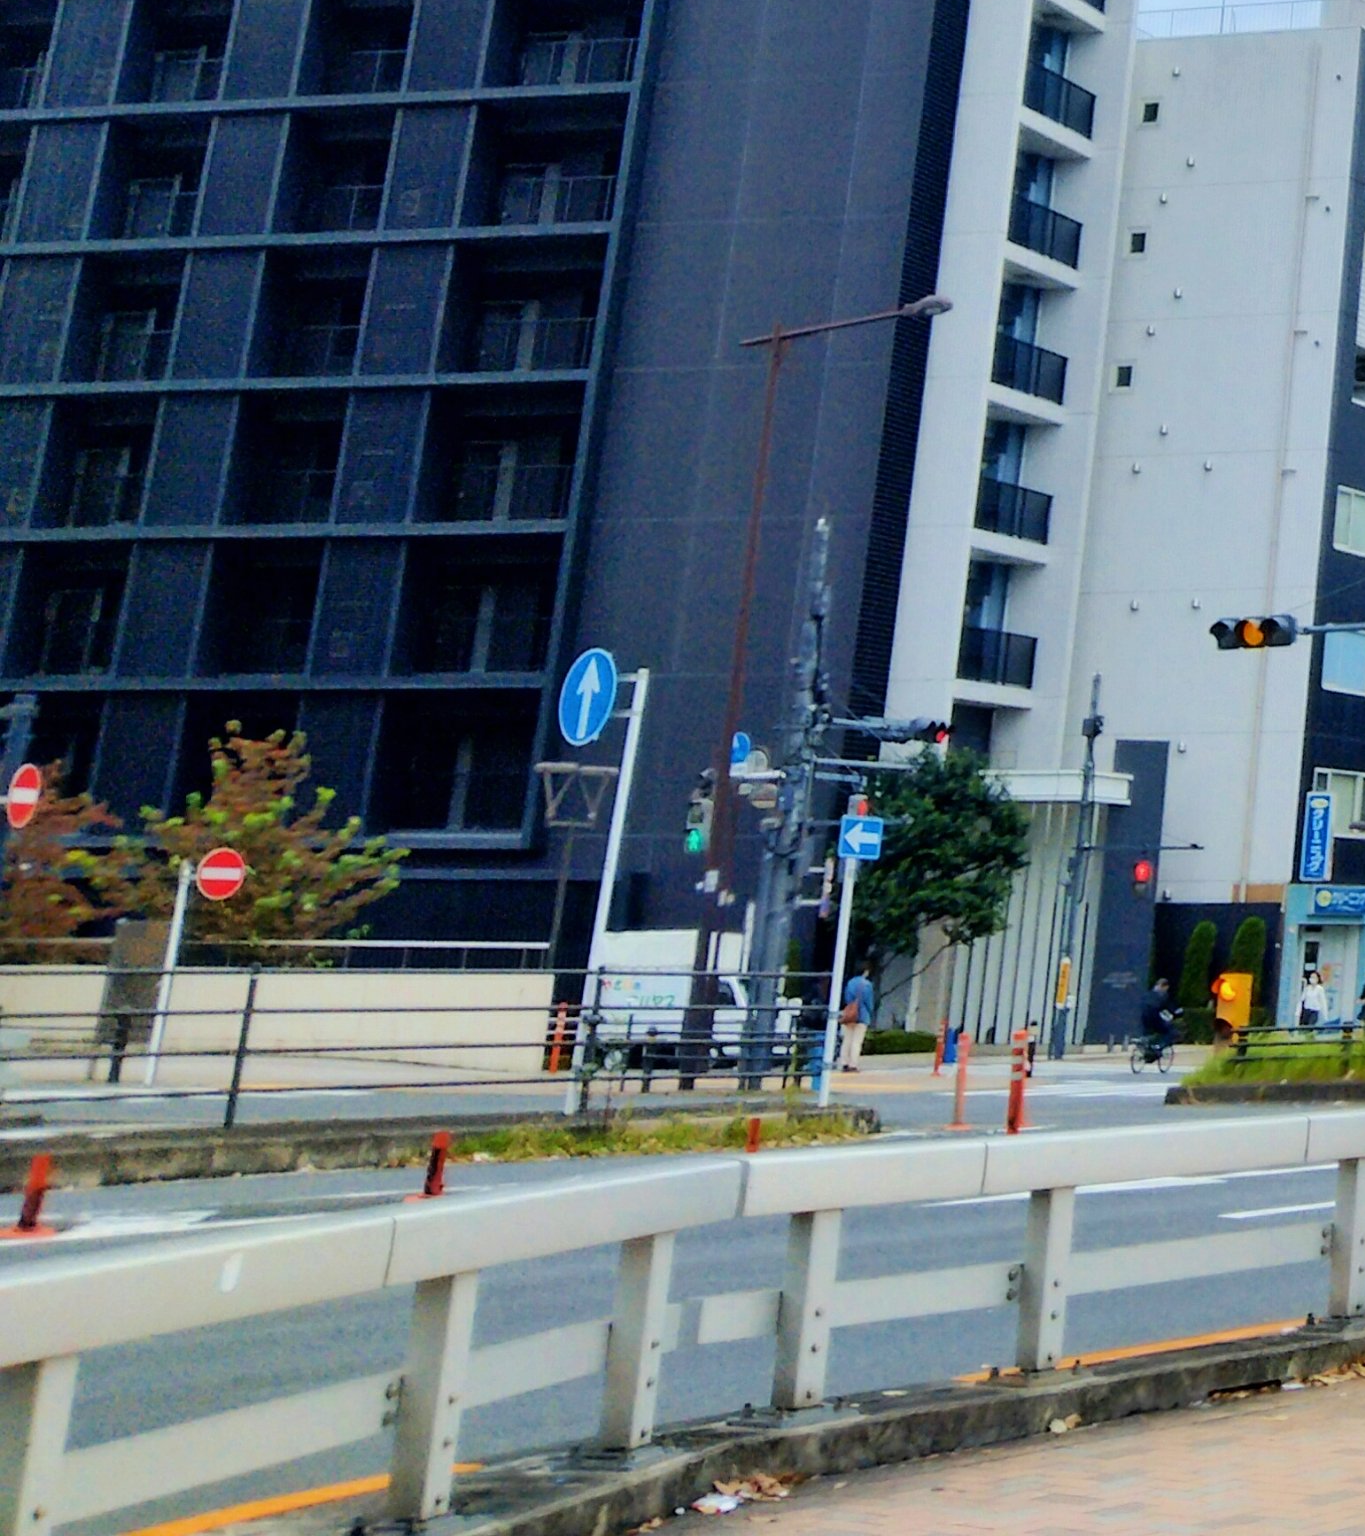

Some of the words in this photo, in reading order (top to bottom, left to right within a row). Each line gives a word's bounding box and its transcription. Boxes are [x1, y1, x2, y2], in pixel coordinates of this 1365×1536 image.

[1306, 809, 1325, 873] クリーニング
